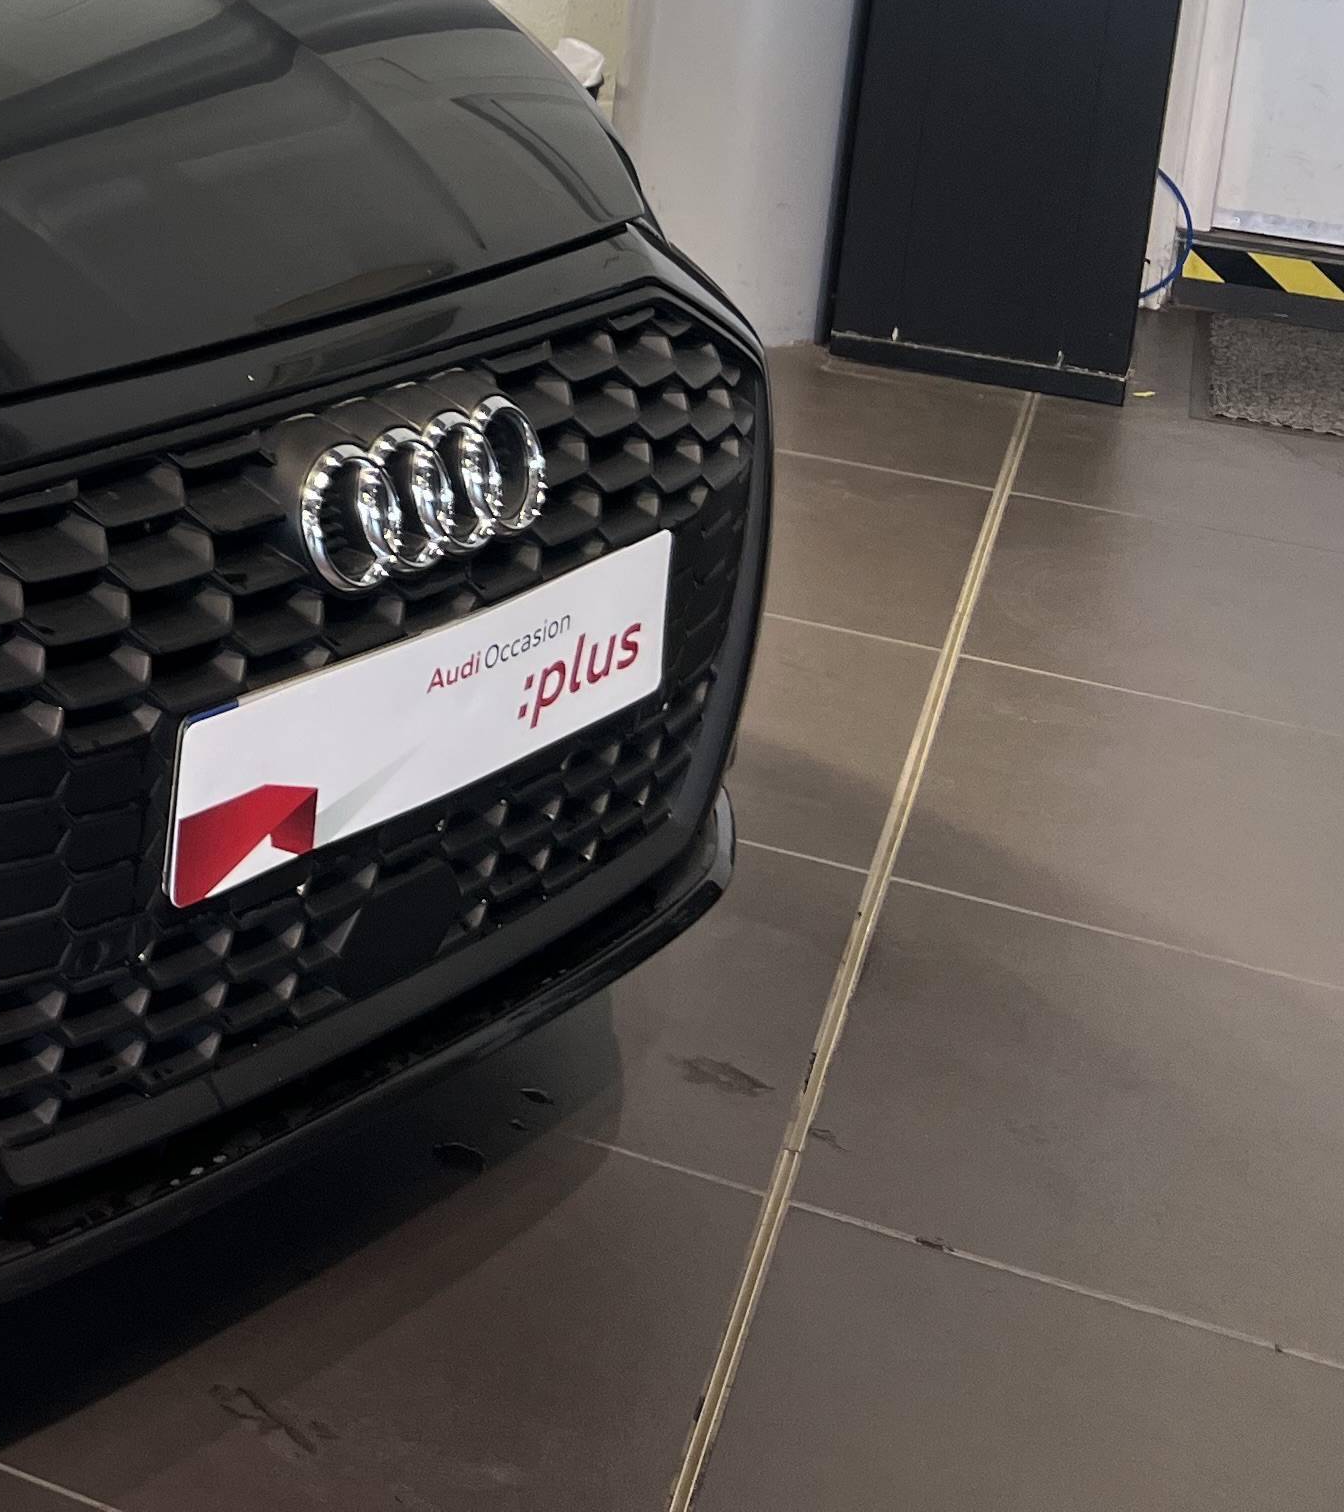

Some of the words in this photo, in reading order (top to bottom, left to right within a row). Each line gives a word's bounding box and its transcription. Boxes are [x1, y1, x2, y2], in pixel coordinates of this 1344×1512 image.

[426, 650, 481, 694] Audi
[484, 612, 572, 670] Occasion
[516, 622, 642, 728] :plus
